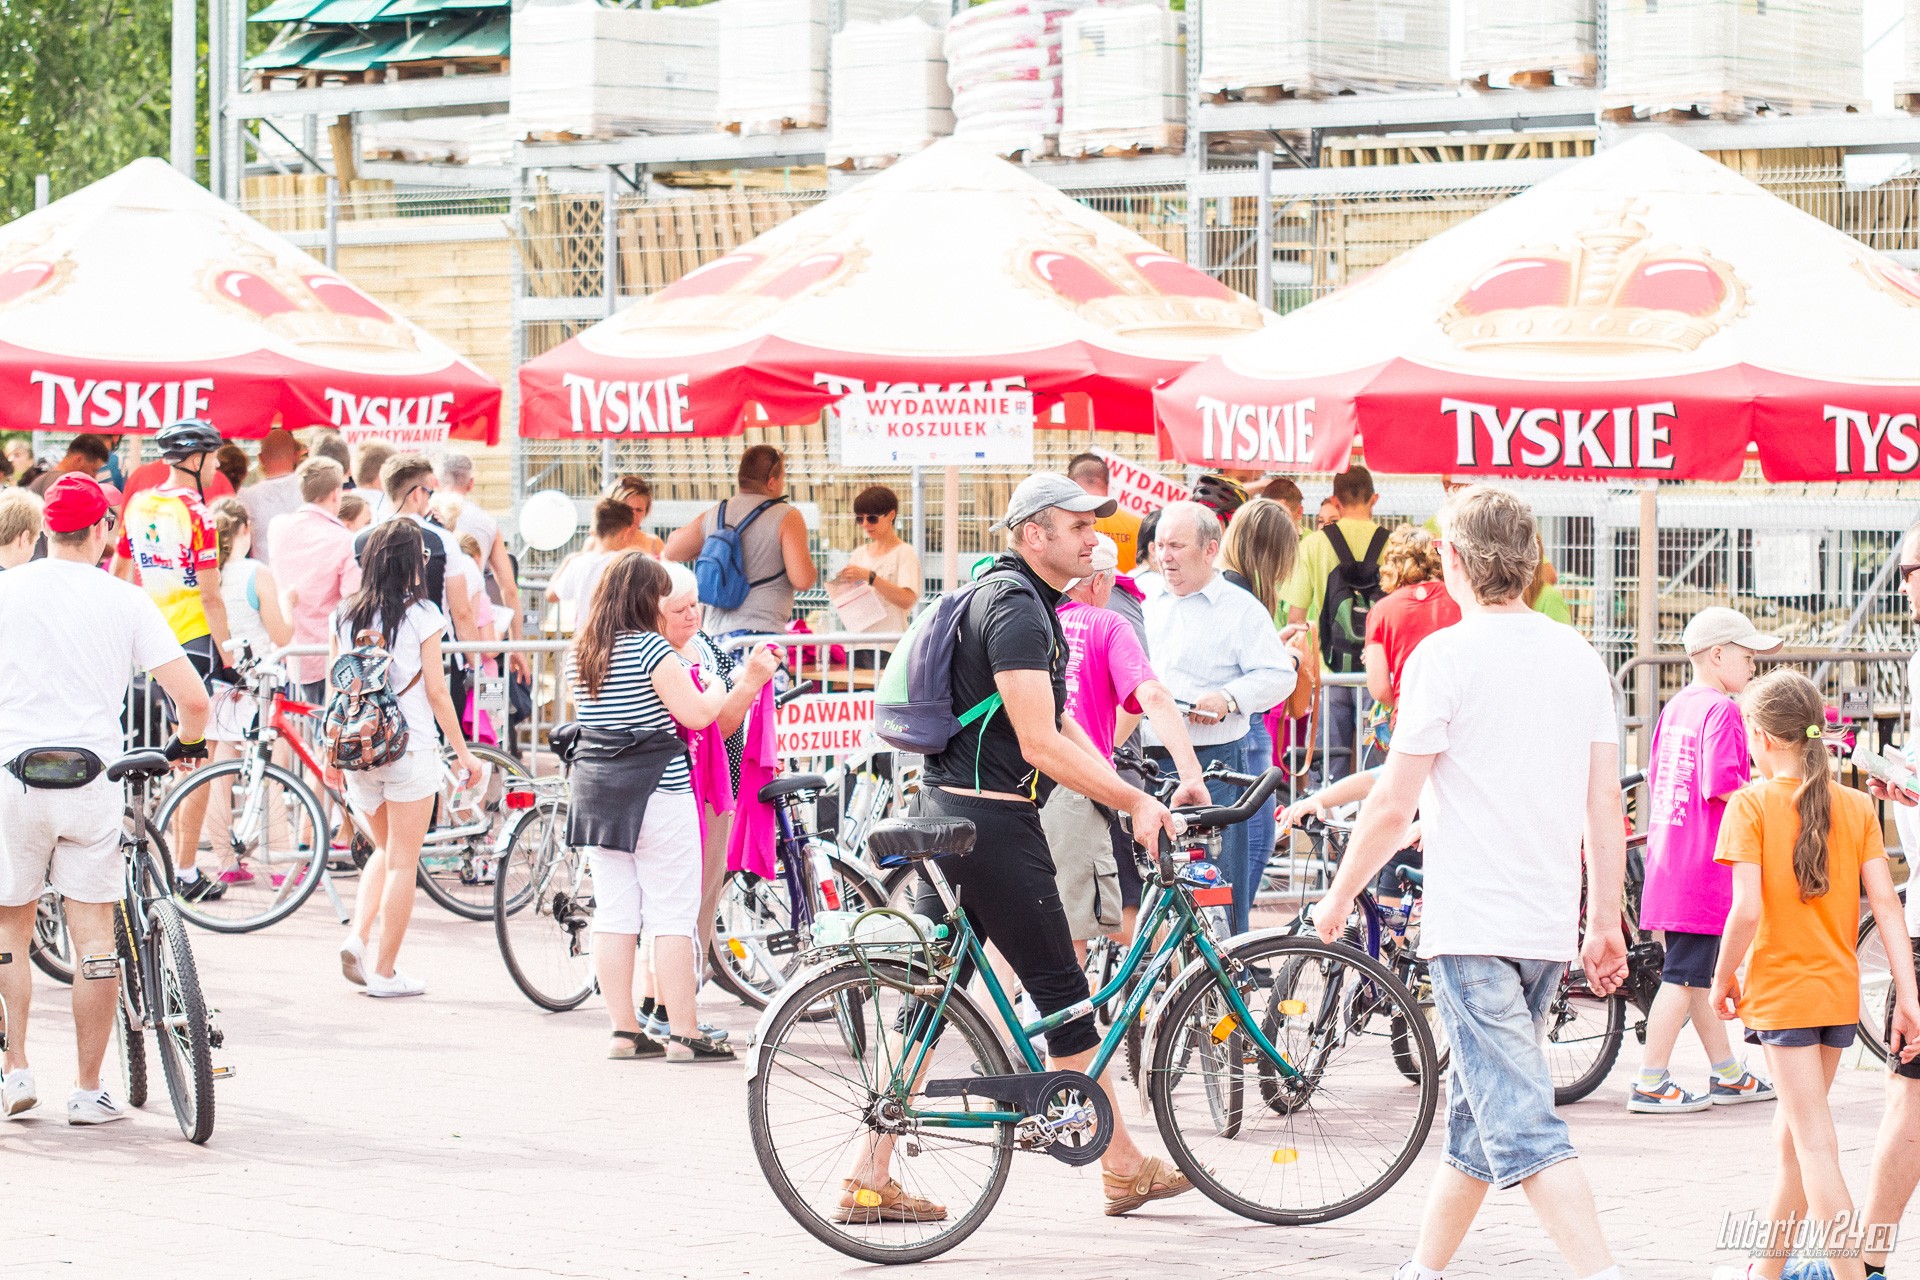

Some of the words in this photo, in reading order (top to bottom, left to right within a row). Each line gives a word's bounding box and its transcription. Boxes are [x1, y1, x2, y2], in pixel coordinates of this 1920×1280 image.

[31, 371, 215, 429] TYSKIE
[324, 387, 455, 429] TYSKIE
[563, 373, 694, 434] TYSKIE
[867, 398, 1010, 416] WYDAWANIE
[887, 422, 987, 437] KOSZULEK
[1196, 397, 1317, 465] TYSKIE
[1441, 397, 1678, 469] TYSKIE
[1104, 457, 1195, 502] WYDAW
[1118, 490, 1164, 516] KOS
[775, 700, 875, 726] YDAWANI
[883, 719, 903, 733] Plus
[777, 730, 862, 753] KOSZULEK
